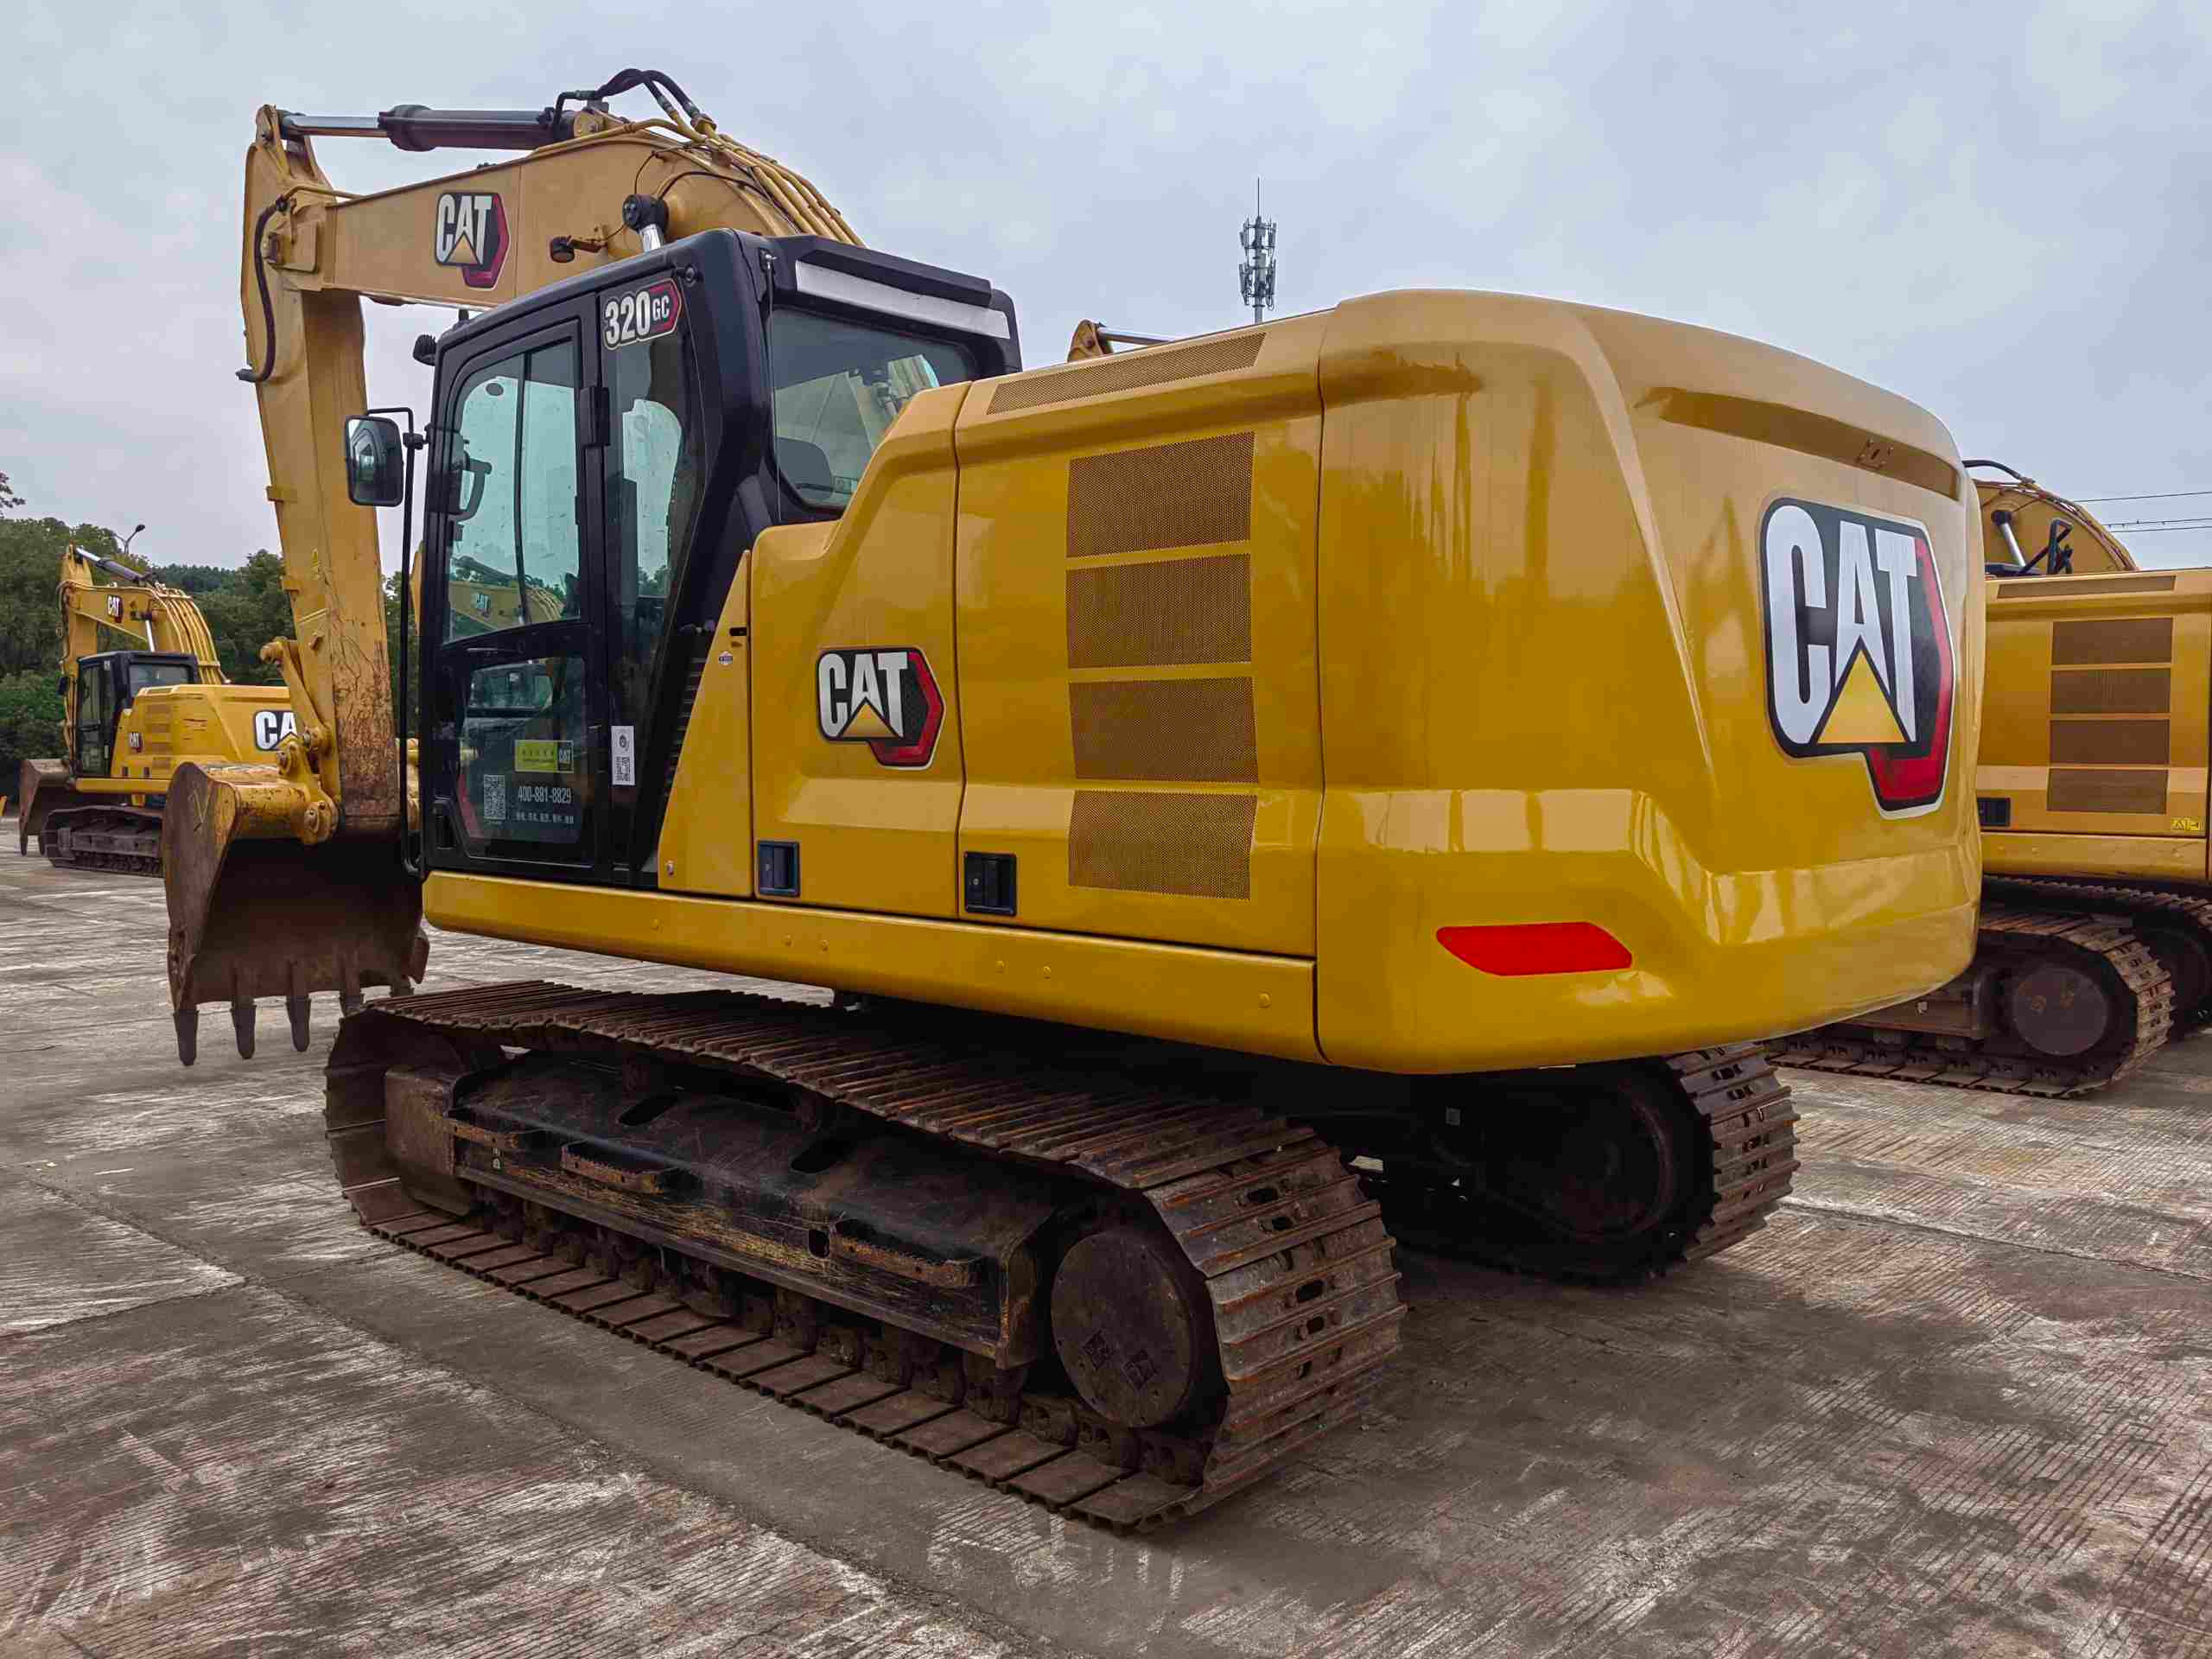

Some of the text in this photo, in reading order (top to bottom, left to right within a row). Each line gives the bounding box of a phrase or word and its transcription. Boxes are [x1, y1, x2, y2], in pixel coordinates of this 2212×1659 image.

[436, 194, 492, 264] CAT
[606, 291, 670, 344] 320 GC
[1766, 505, 1917, 744] CAT
[819, 652, 907, 738] CAT
[256, 711, 298, 750] CA
[518, 786, 572, 804] 400-881-8829
